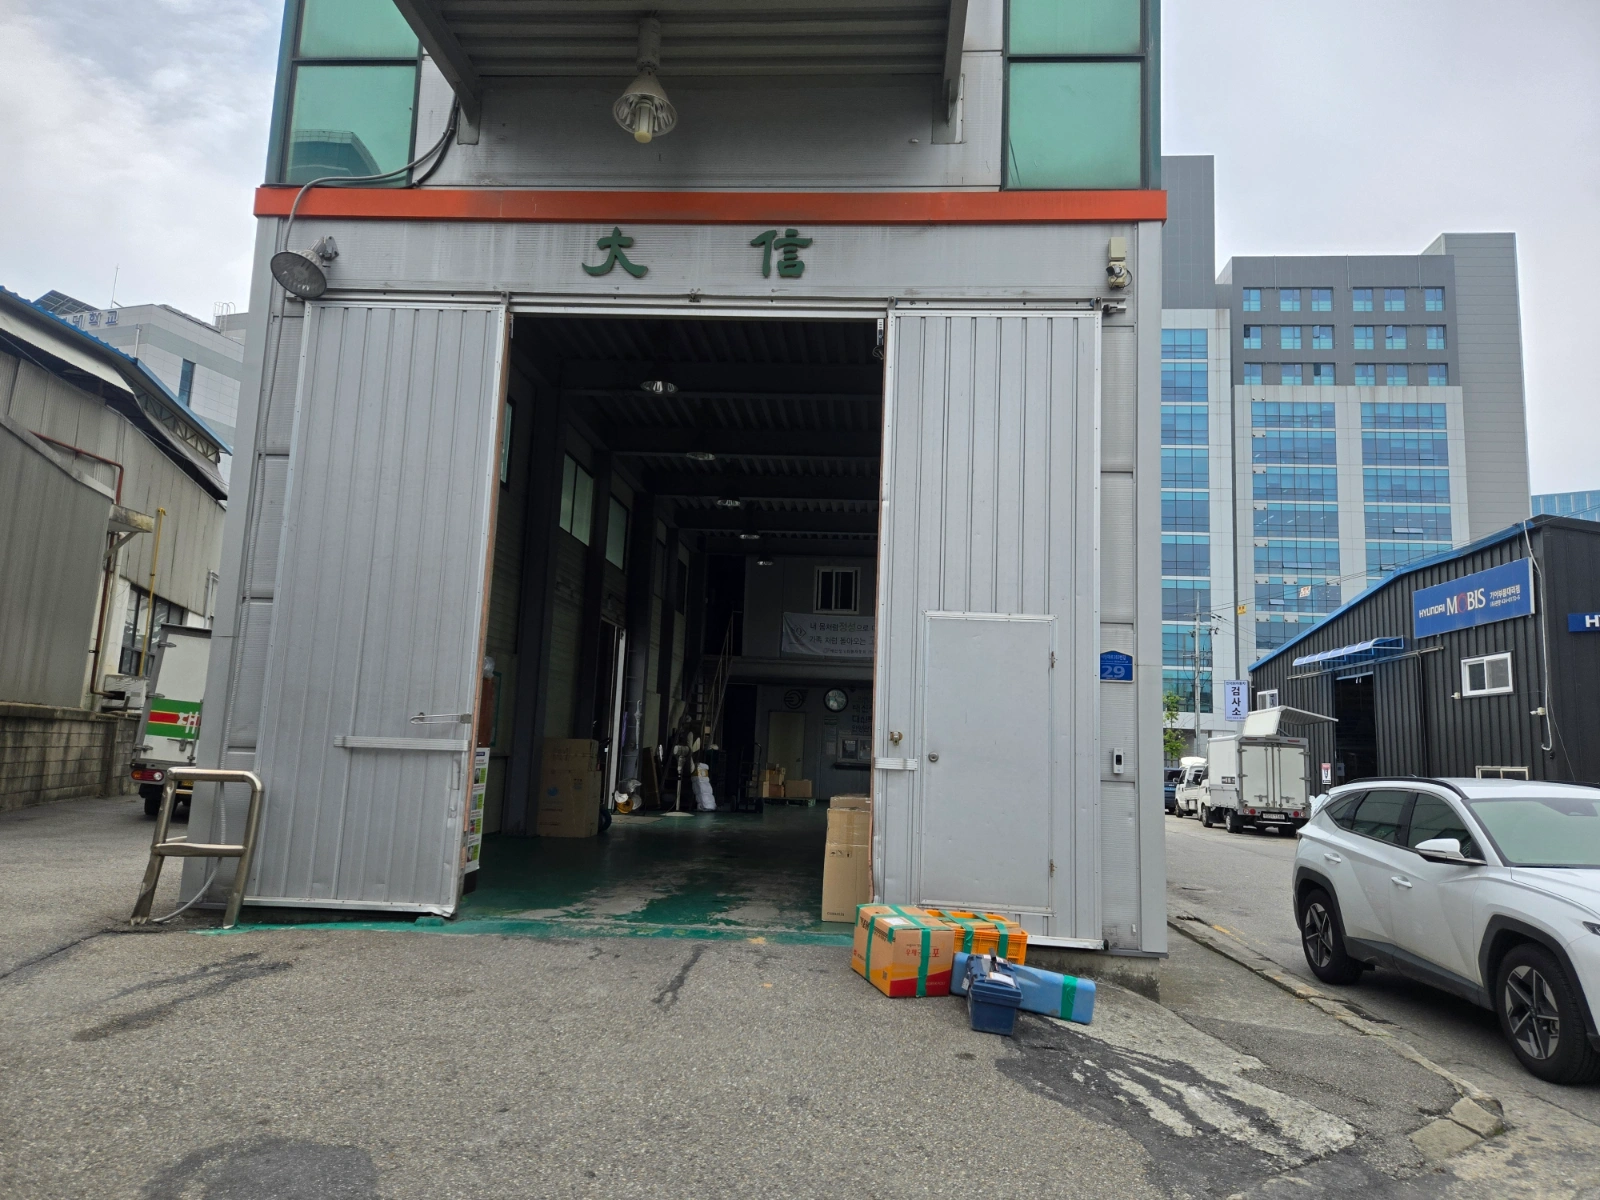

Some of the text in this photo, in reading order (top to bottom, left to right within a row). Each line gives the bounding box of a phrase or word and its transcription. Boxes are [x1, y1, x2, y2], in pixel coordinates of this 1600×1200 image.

[1418, 603, 1445, 618] HYUNDAI
[1446, 588, 1486, 616] MOBIS
[1489, 584, 1521, 600] 기아부품대리점
[1101, 665, 1126, 679] 29
[1231, 686, 1241, 716] 검사소
